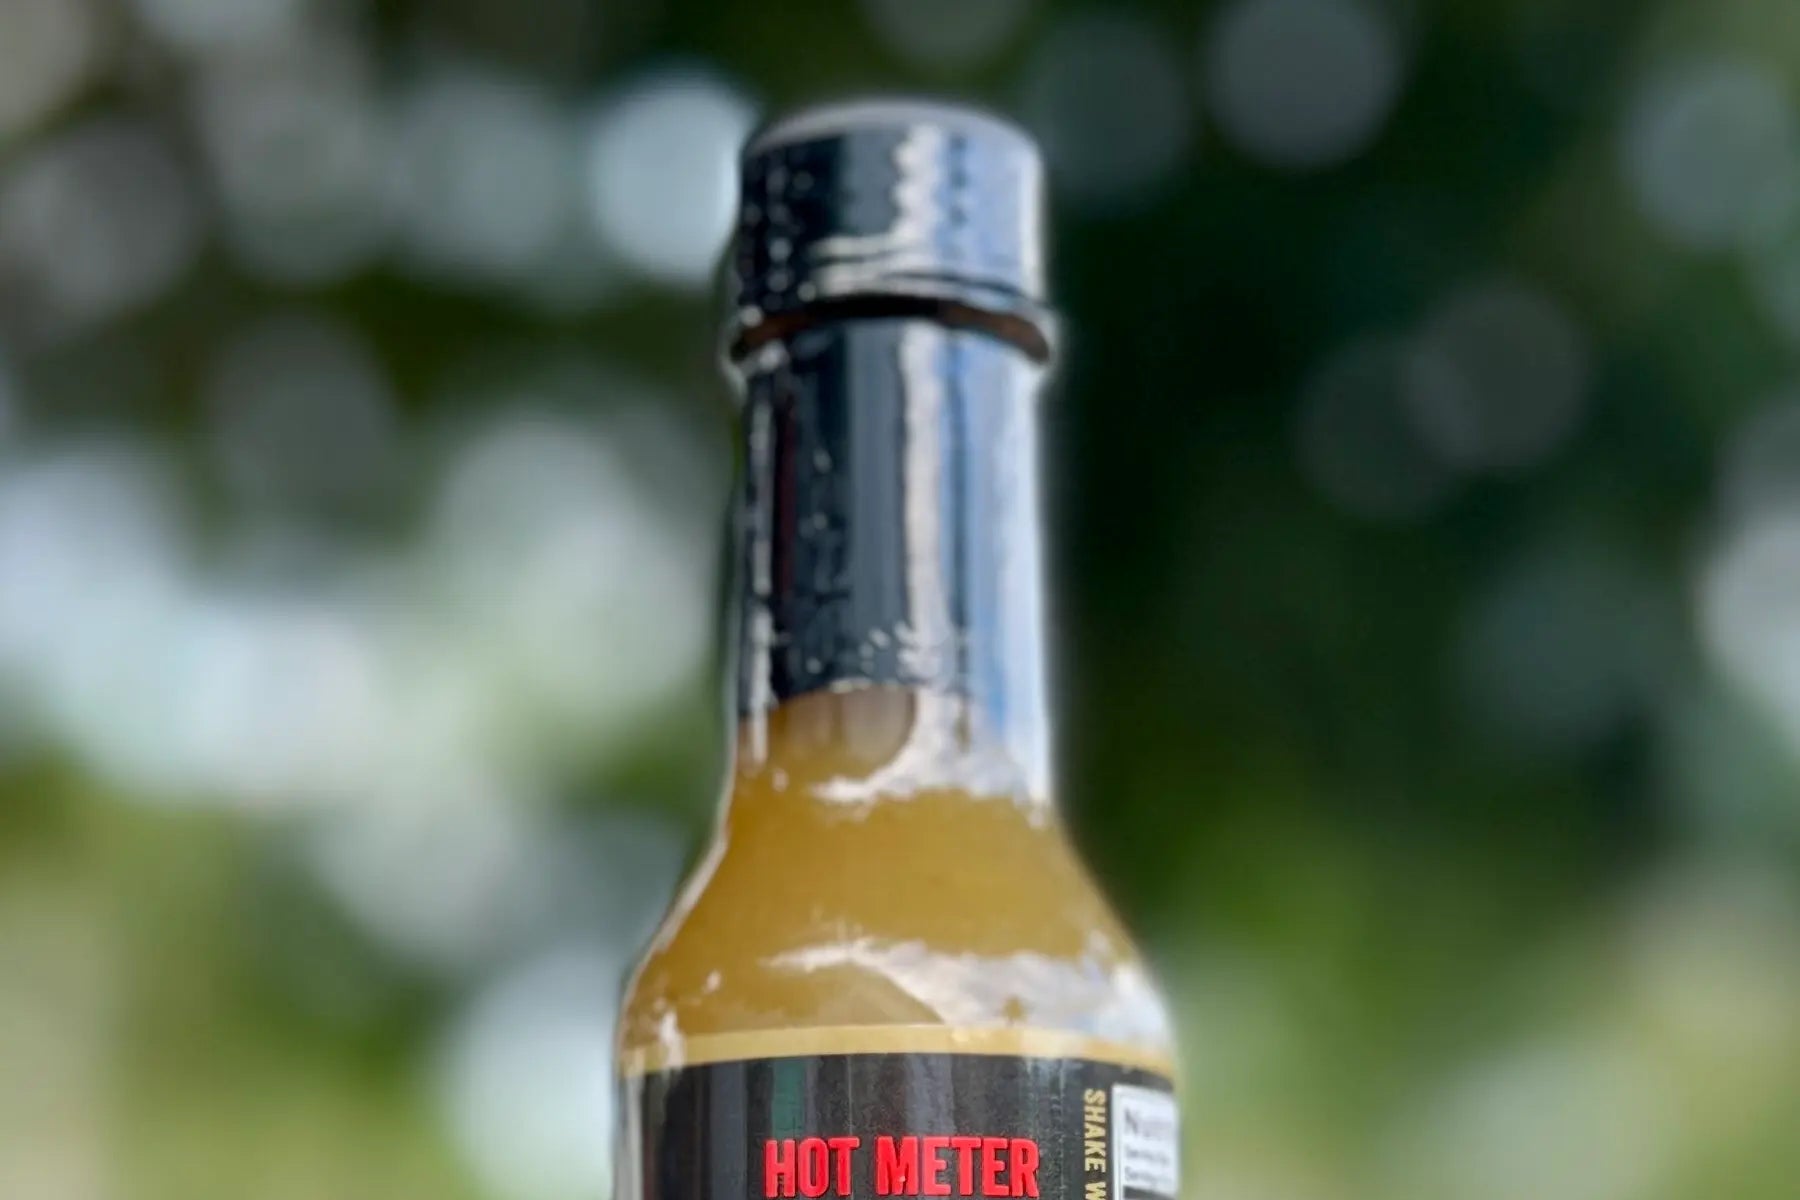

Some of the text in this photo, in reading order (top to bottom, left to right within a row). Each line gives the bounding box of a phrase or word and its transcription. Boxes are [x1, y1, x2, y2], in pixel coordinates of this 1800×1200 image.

[765, 1134, 1040, 1198] HOT METER
[1084, 1088, 1106, 1173] SHAKE
